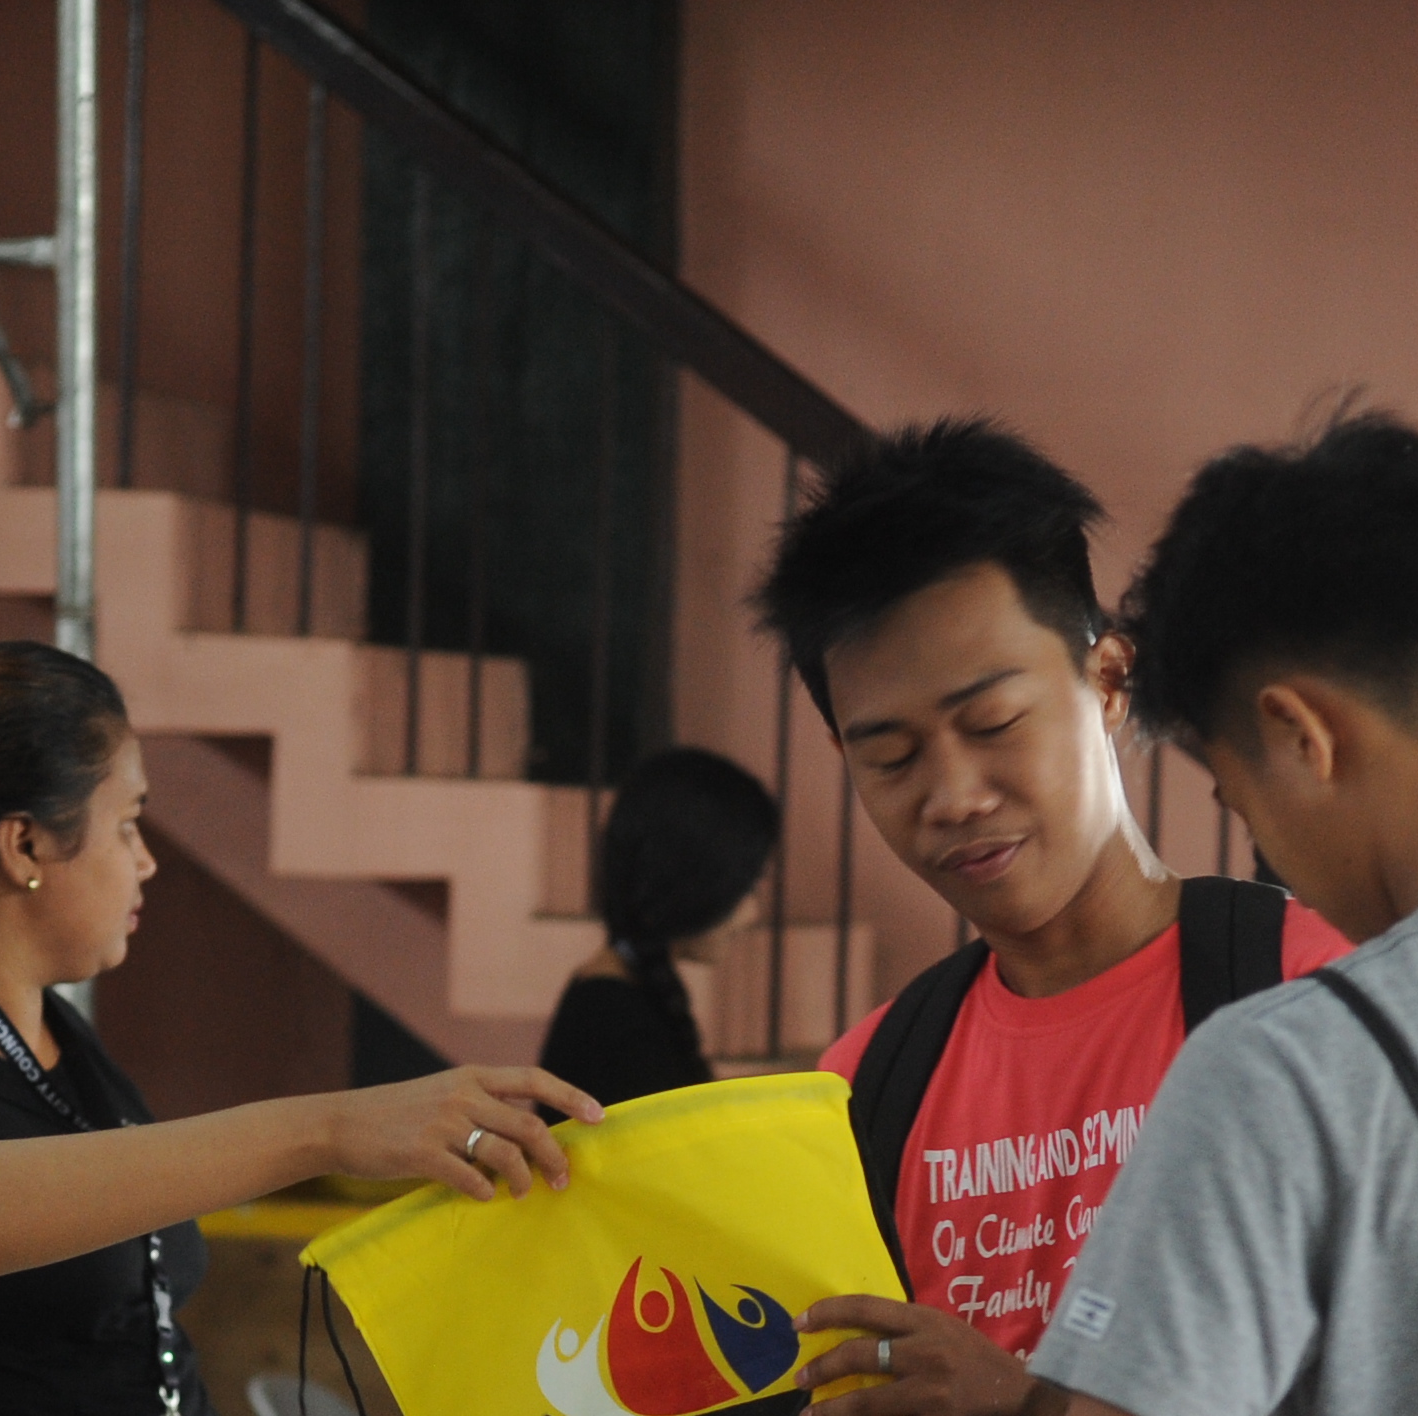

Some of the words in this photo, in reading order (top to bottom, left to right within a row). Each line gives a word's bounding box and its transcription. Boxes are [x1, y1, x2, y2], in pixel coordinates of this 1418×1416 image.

[922, 1133, 1036, 1204] TRAINING
[1035, 1128, 1081, 1183] AND
[932, 1219, 966, 1267] On
[947, 1269, 1052, 1325] Family
